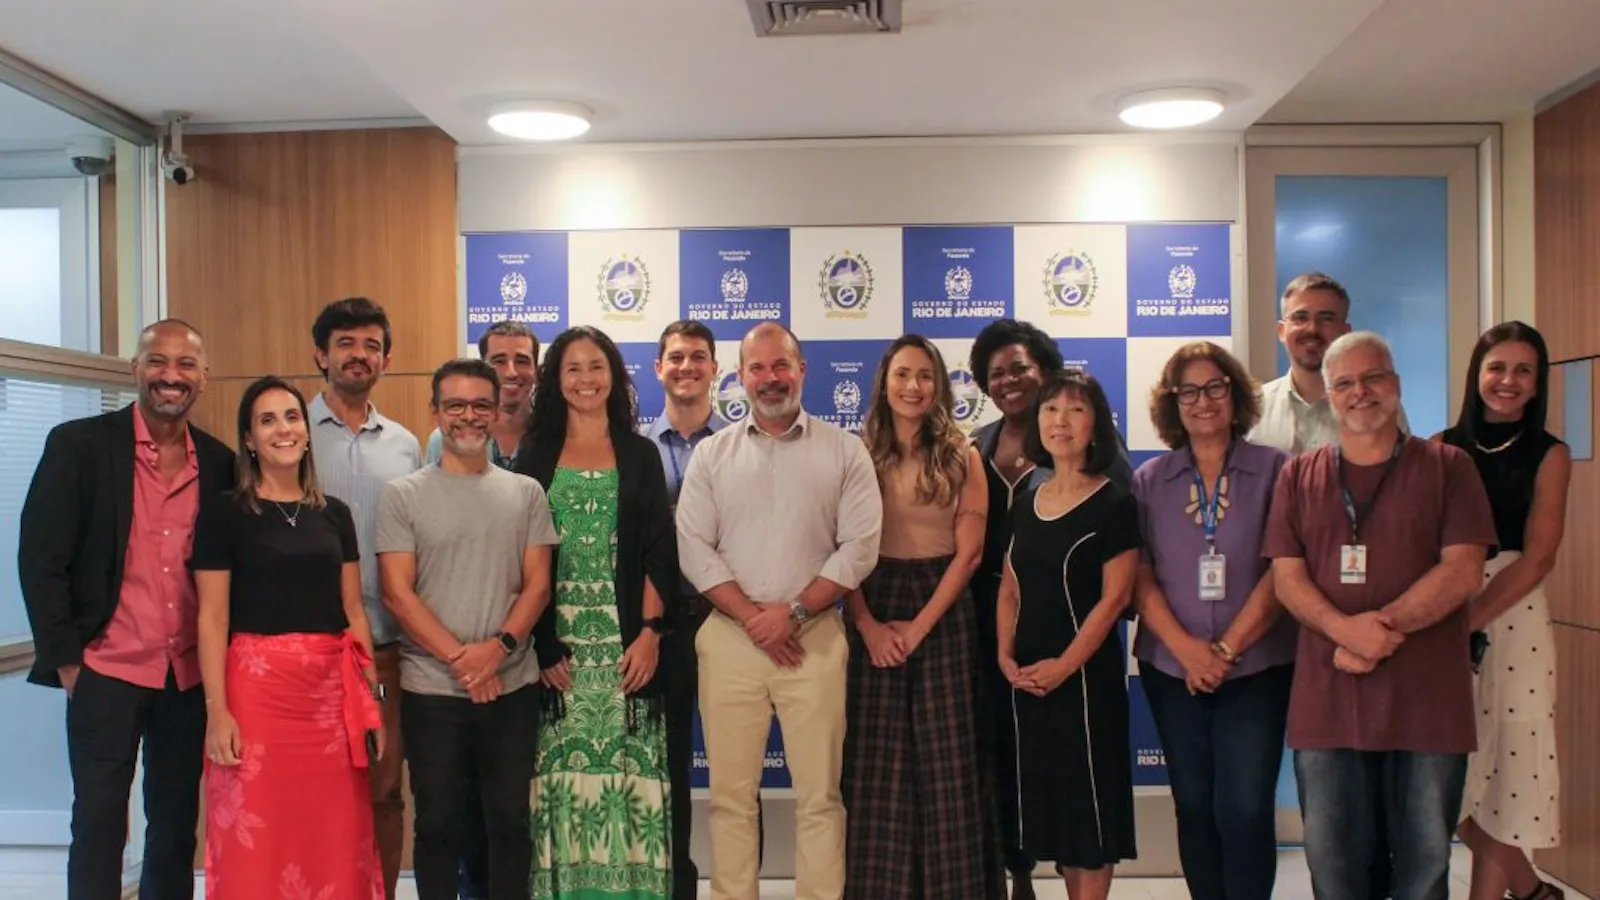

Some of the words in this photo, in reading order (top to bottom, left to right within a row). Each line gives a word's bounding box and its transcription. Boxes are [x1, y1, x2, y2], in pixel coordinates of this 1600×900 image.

[689, 310, 711, 320] RIO
[712, 310, 729, 320] DE
[730, 309, 781, 320] JANEIRO
[912, 308, 935, 318] RIO
[935, 308, 952, 318] DE
[954, 307, 1005, 317] JANEIRO
[1136, 306, 1158, 317] RIO
[1160, 306, 1176, 316] DE
[1178, 305, 1229, 315] JANEIRO
[469, 313, 490, 323] RIO
[492, 313, 508, 322] DE
[510, 312, 559, 322] JANEIRO
[1137, 756, 1159, 766] RIO
